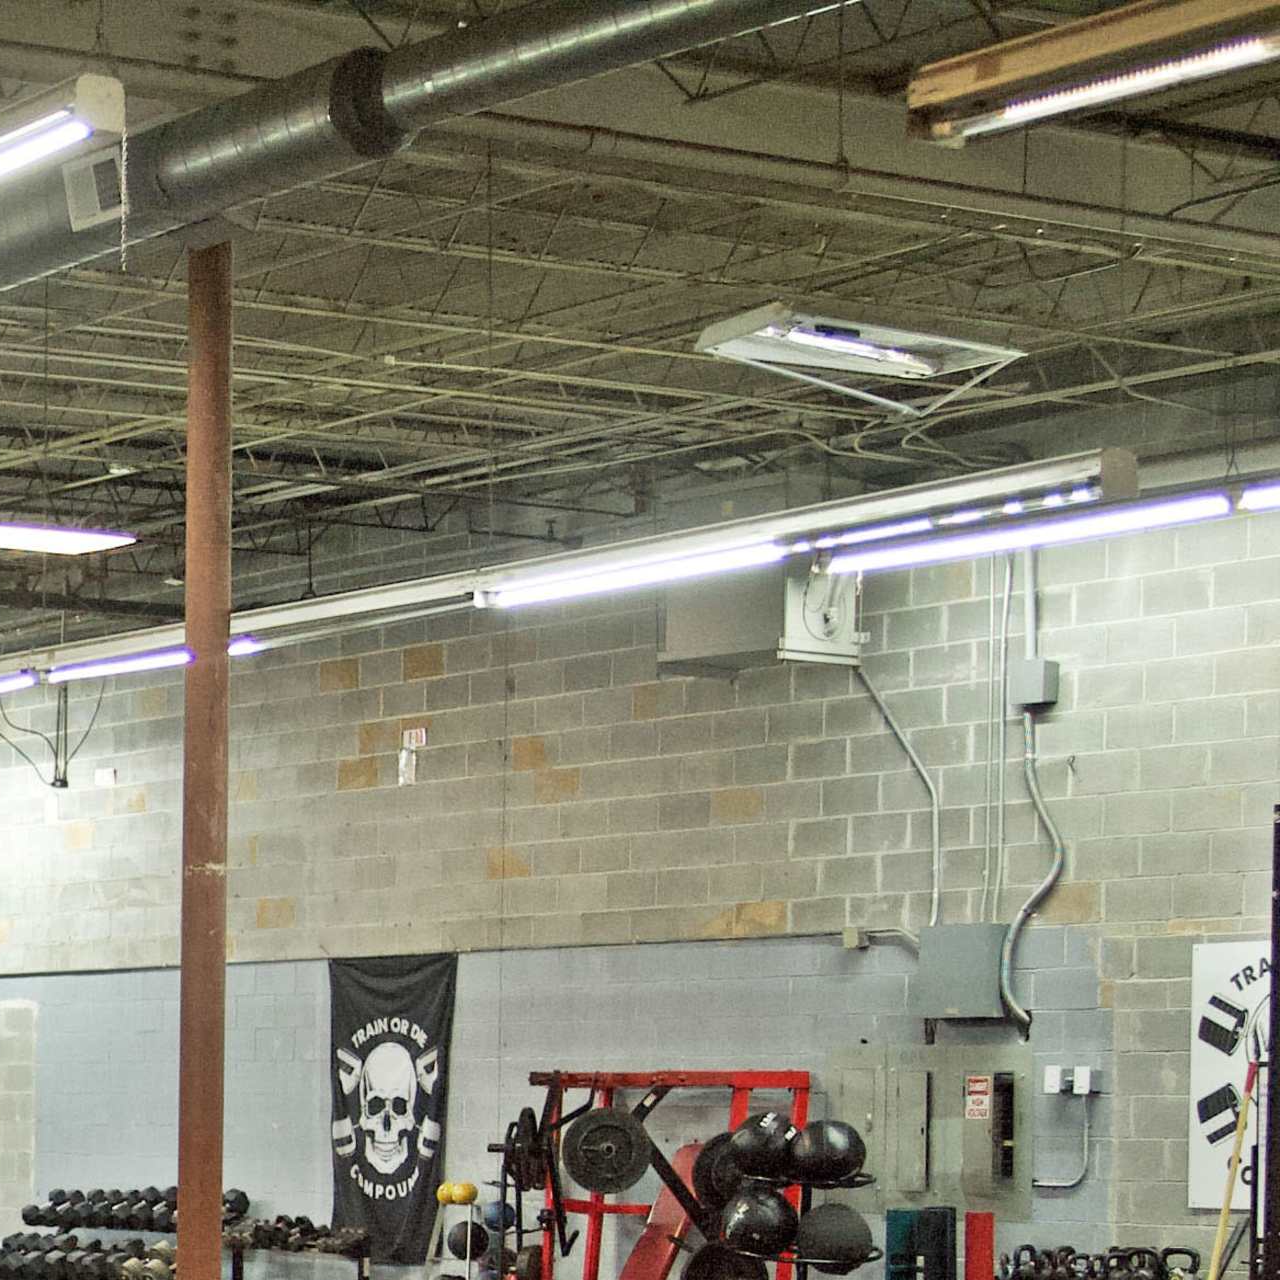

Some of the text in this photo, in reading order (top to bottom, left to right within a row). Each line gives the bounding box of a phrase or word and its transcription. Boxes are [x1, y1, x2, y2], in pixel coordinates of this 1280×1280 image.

[352, 1017, 428, 1049] TRAIN OR DIE
